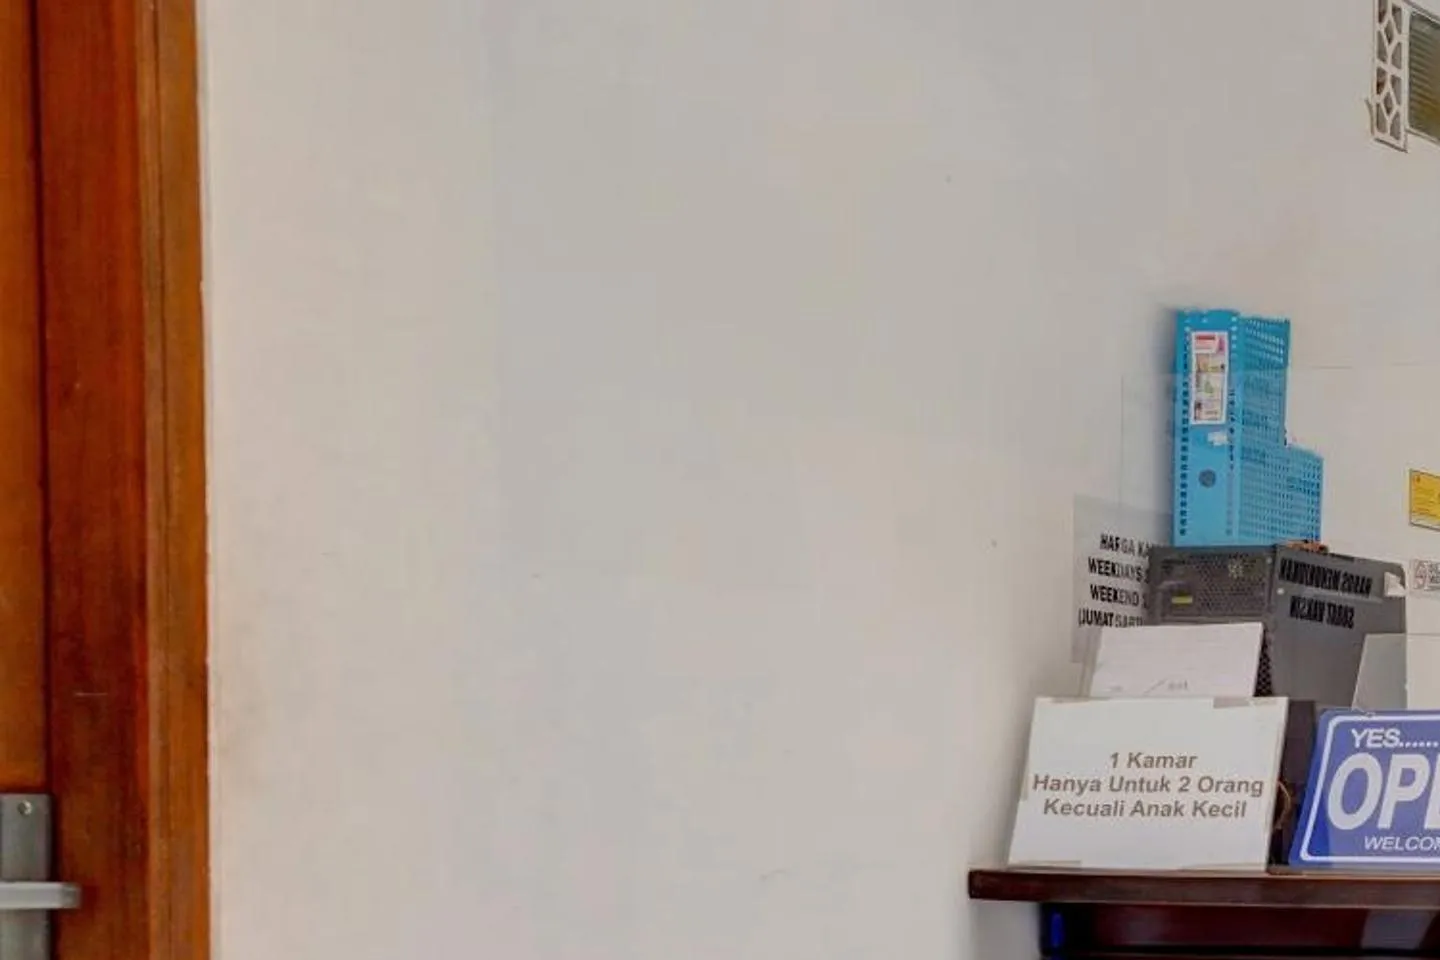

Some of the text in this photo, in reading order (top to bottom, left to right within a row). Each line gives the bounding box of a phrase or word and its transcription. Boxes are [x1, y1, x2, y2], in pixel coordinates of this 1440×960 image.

[1110, 752, 1198, 769] 1 Kamar
[1032, 774, 1264, 797] Hanya Untuk 2 Orang
[1043, 798, 1247, 819] Kecuali Anak Kecil
